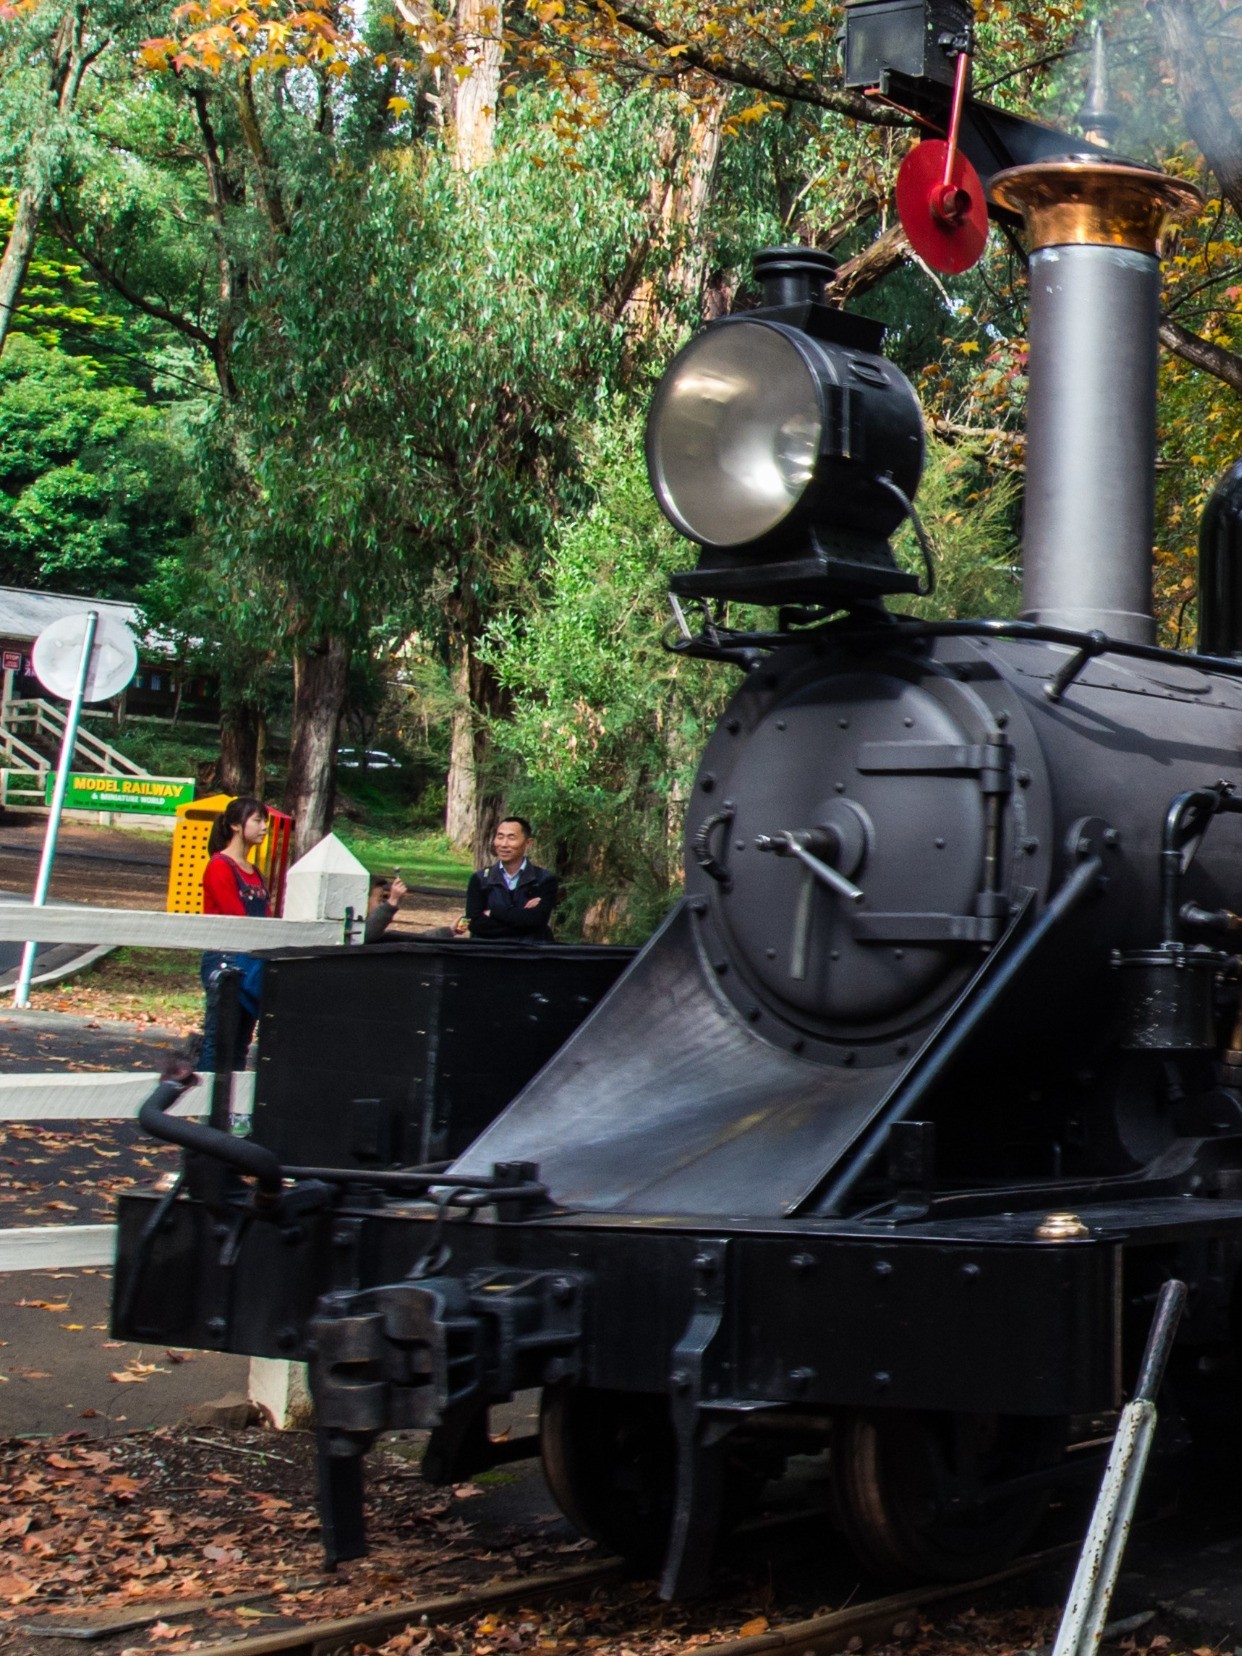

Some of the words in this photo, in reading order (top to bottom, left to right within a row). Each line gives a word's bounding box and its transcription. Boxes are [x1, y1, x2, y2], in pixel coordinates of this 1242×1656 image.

[73, 777, 119, 792] MODEL
[122, 782, 183, 797] RAILWAY
[100, 793, 139, 803] MINIATURE
[141, 796, 165, 805] WORLD
